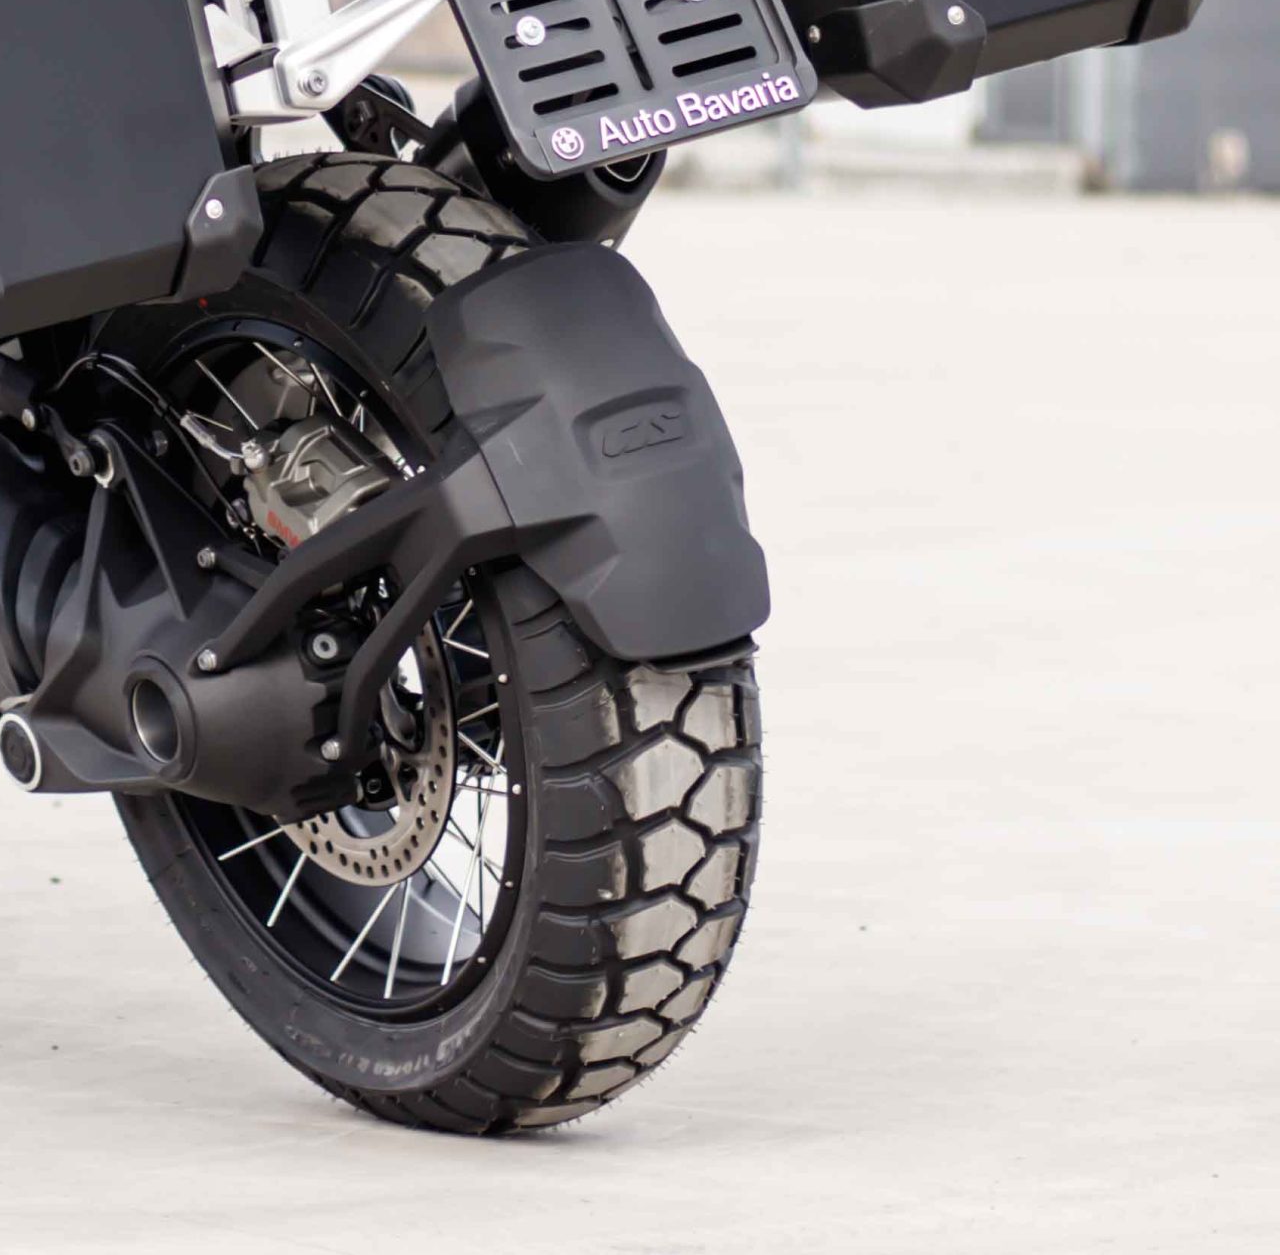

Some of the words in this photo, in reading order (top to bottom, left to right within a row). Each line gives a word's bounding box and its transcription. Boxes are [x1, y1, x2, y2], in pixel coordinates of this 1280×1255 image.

[599, 108, 677, 150] Auto
[676, 72, 799, 127] Bavaria
[601, 412, 684, 459] GS
